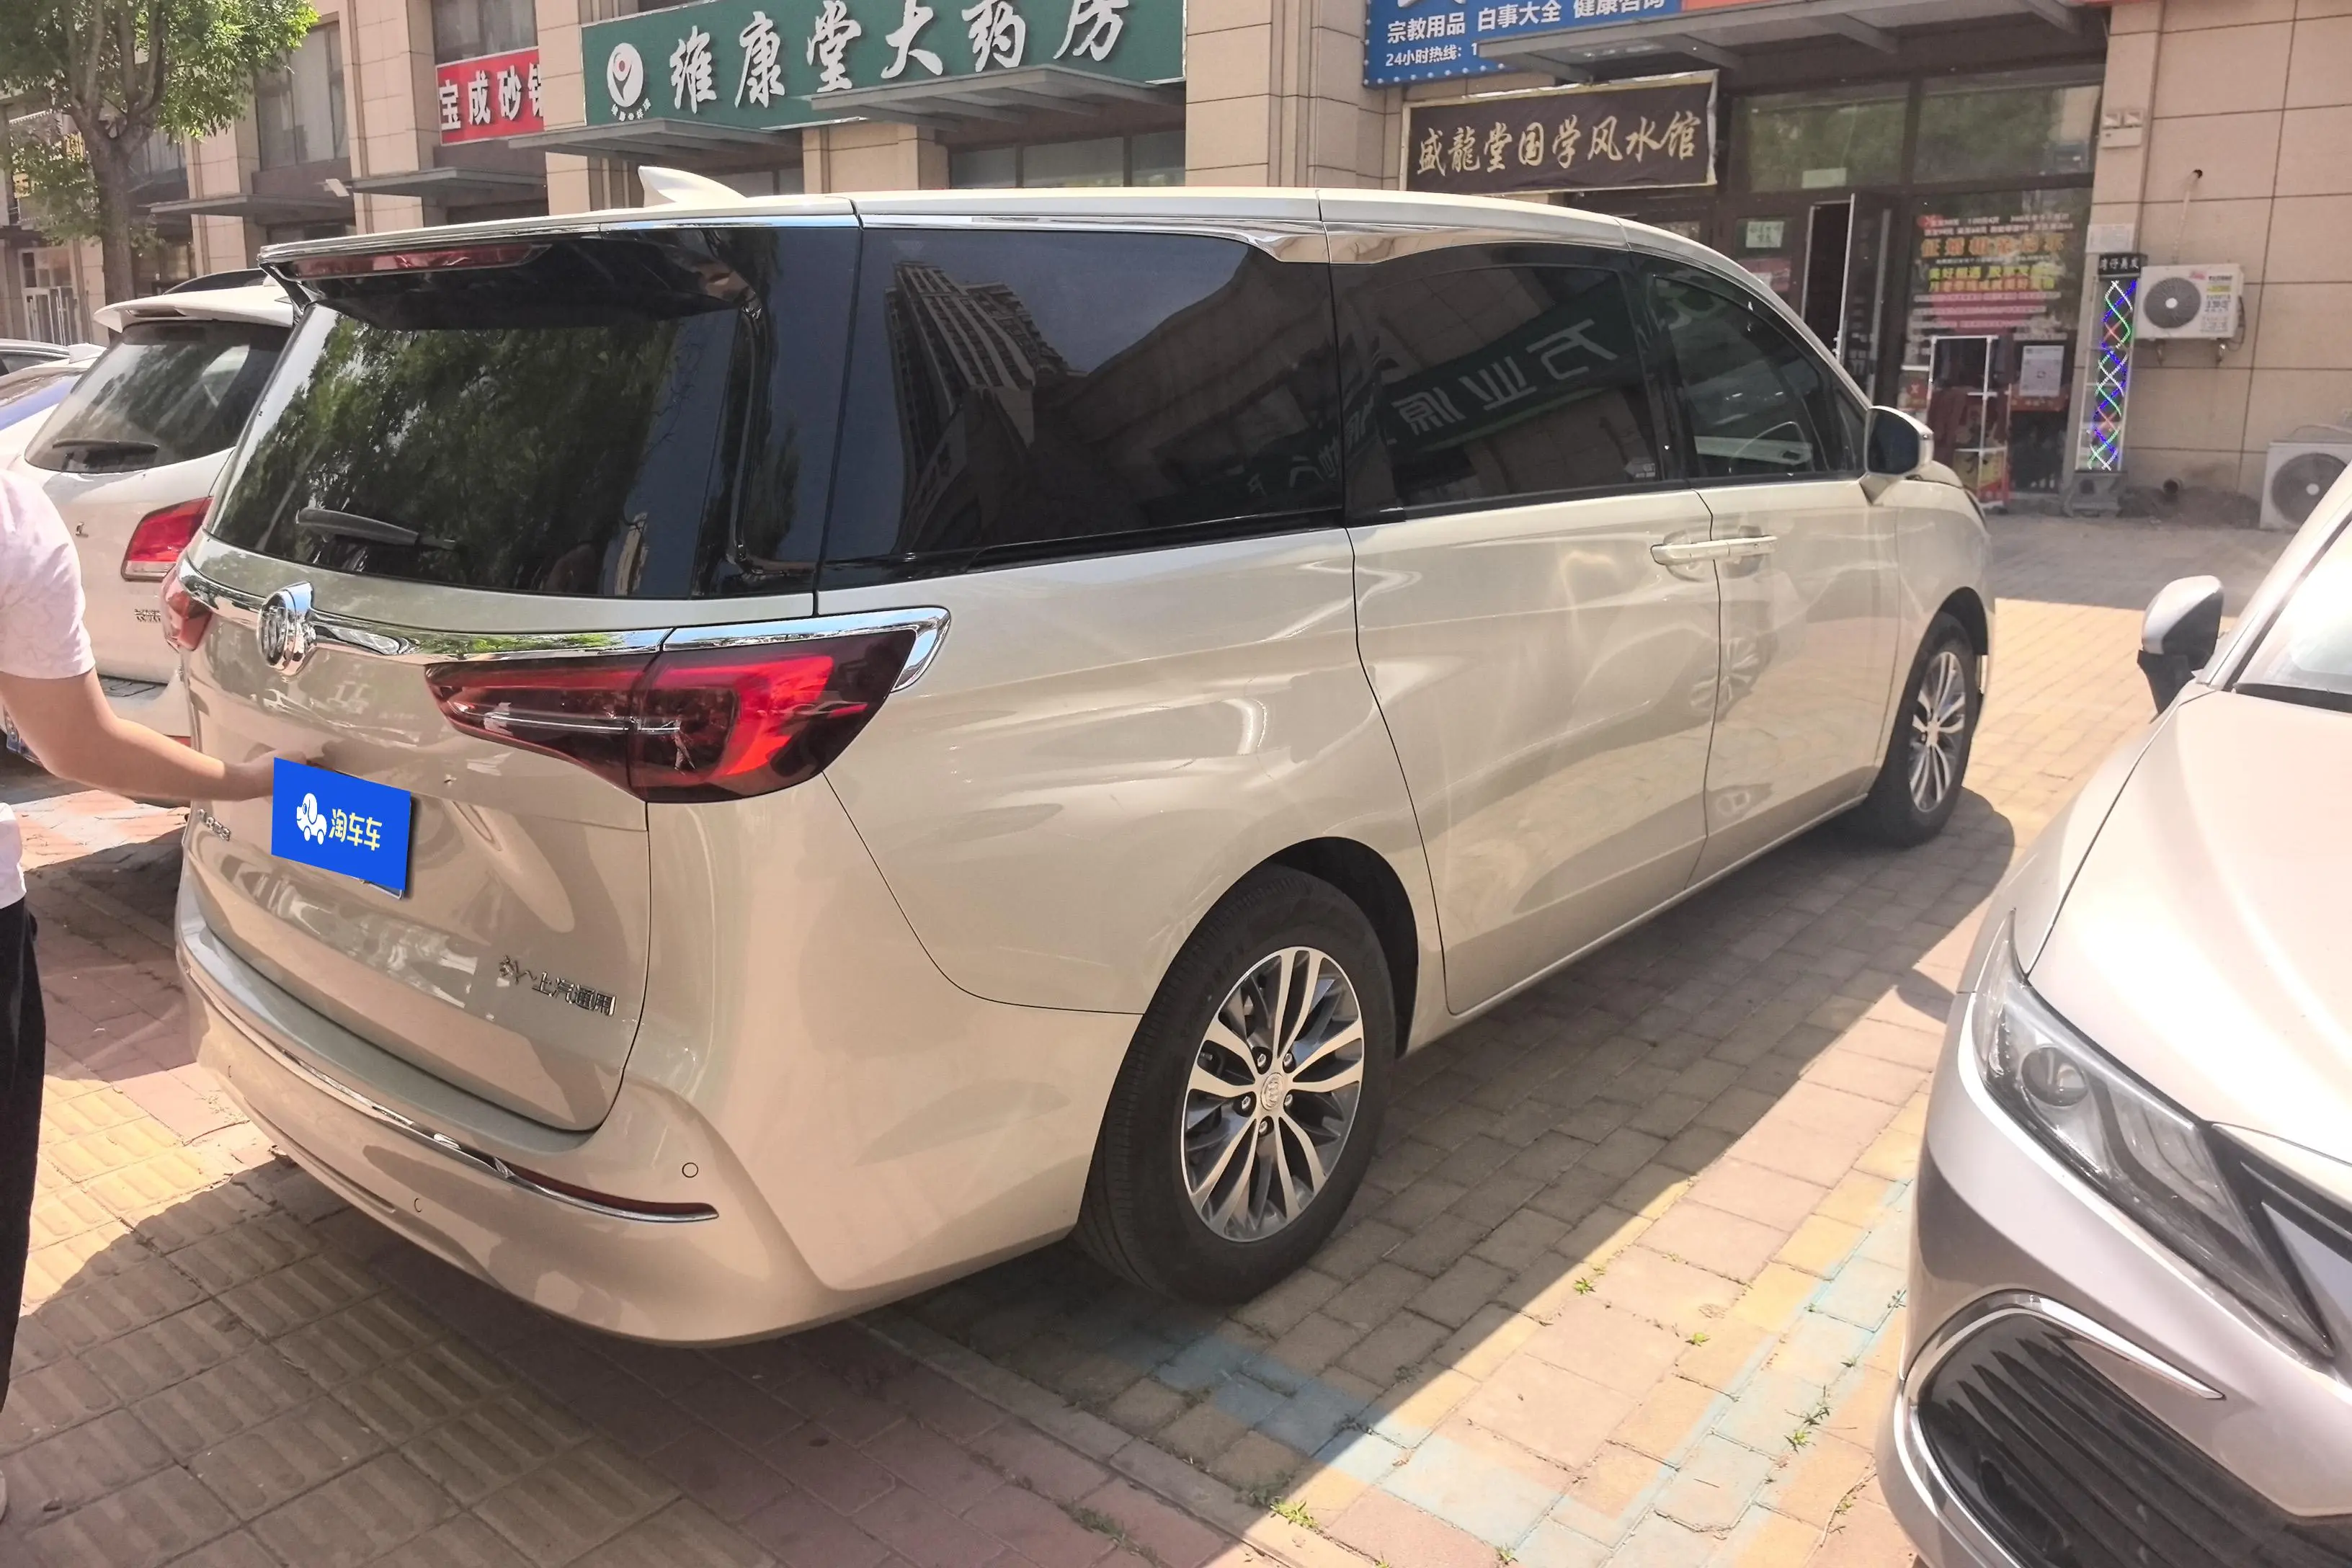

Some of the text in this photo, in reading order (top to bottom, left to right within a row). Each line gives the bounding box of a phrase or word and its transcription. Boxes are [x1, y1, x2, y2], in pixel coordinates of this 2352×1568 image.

[669, 0, 1129, 114] 维康堂大药房
[1387, 12, 1465, 44] 宗教用品
[1477, 1, 1562, 32] 白事大全
